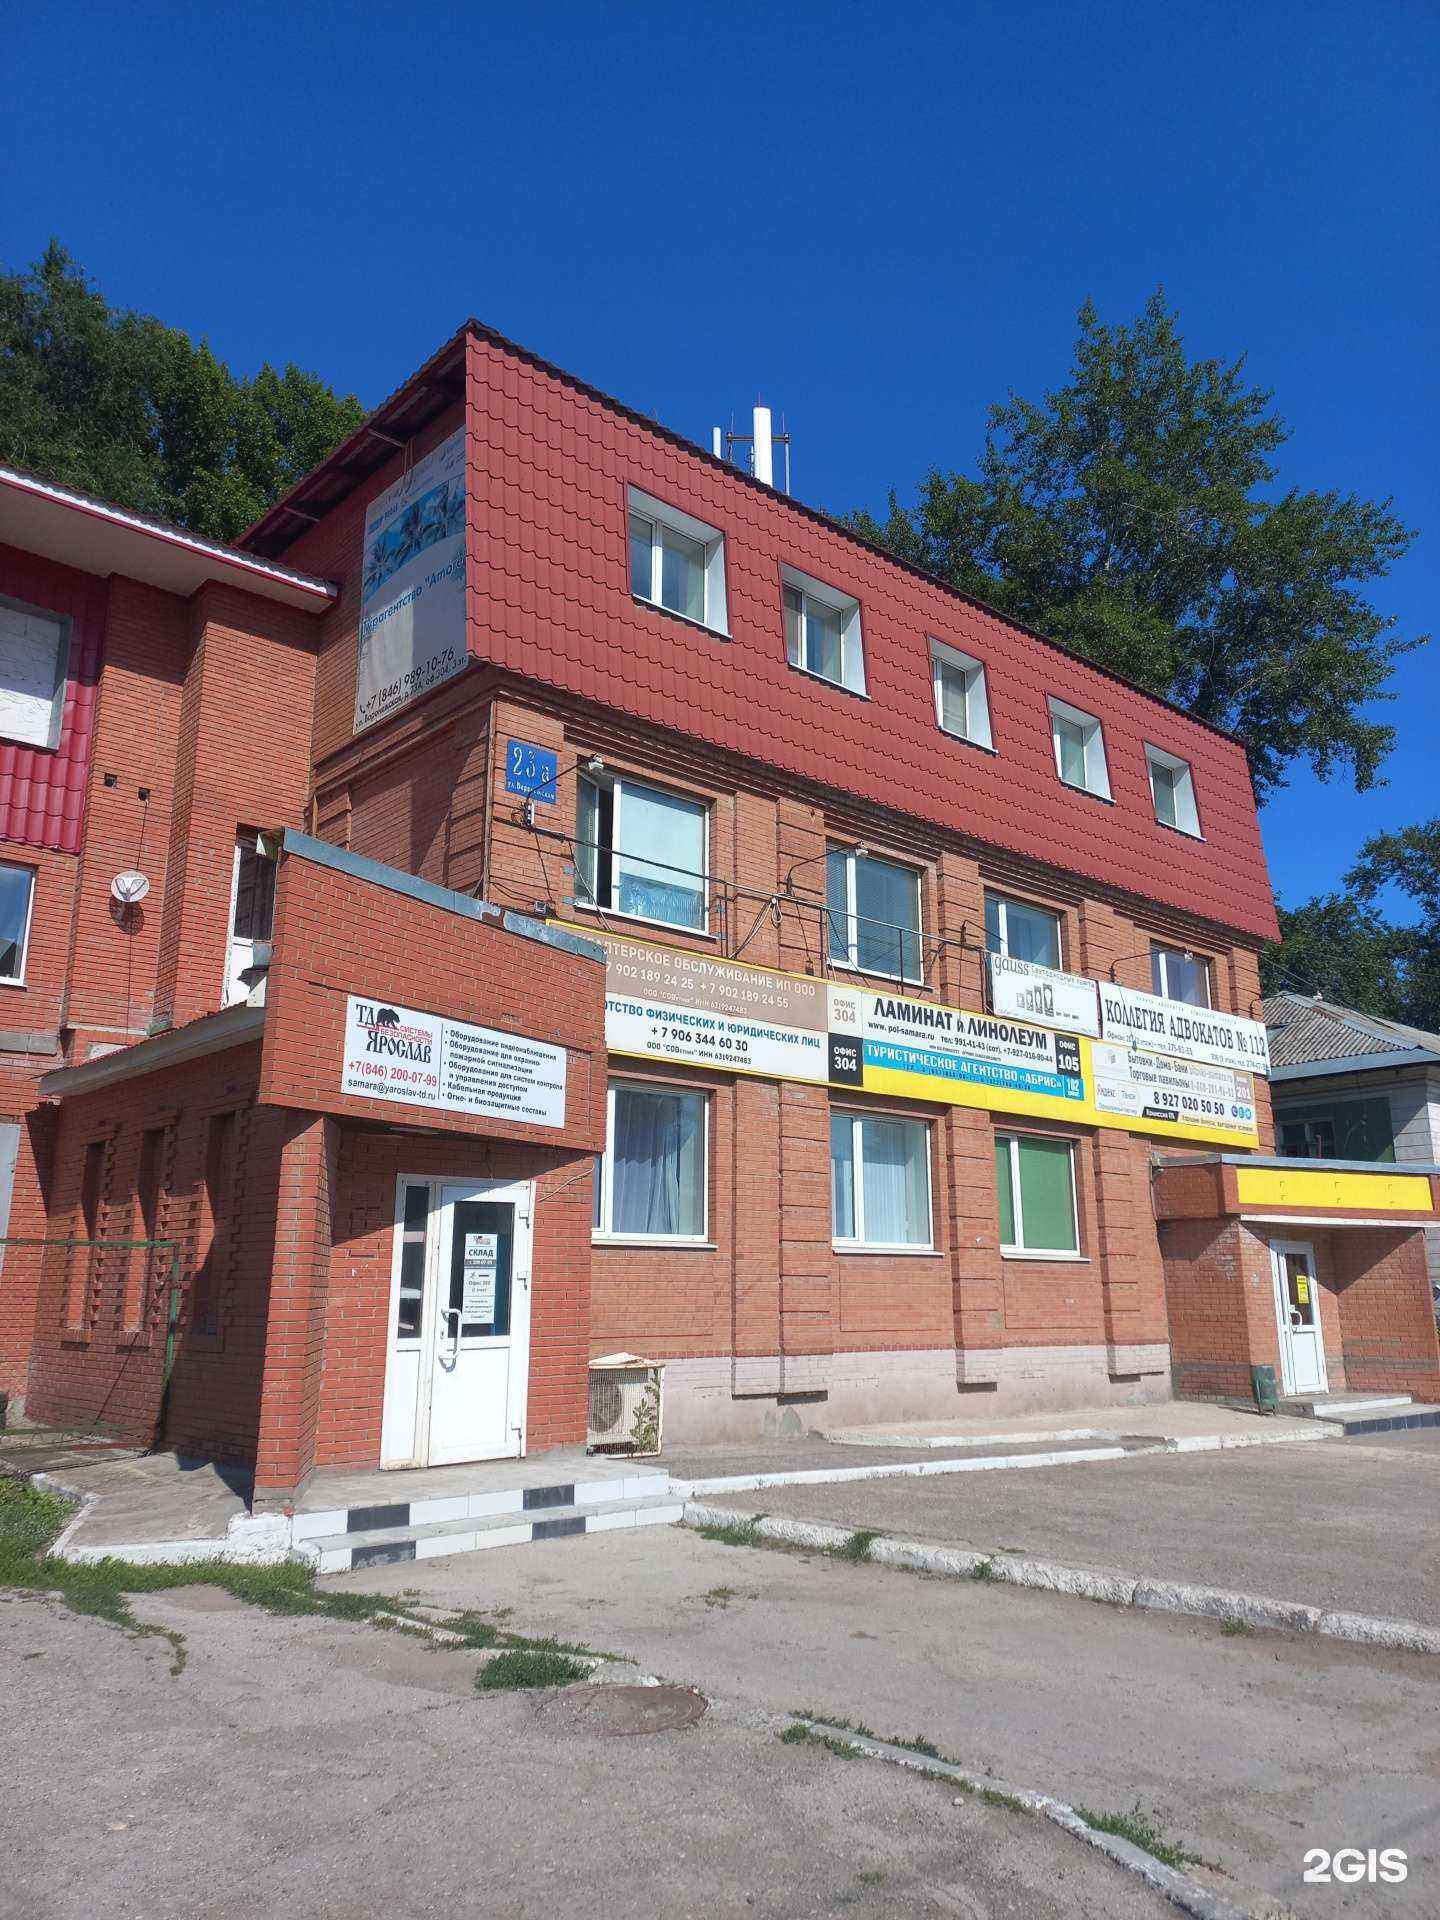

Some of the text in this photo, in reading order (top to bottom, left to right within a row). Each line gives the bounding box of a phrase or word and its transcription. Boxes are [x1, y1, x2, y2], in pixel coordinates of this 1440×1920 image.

[378, 677, 401, 706] (846)
[404, 647, 455, 687] 989-10-76
[674, 956, 773, 989] ОБСЛУЖИВАНИЕ
[776, 980, 791, 991] ИП
[795, 983, 815, 997] ООО
[994, 956, 1029, 976] gauss
[616, 964, 637, 978] 902
[641, 969, 661, 982] 189
[664, 974, 677, 987] 24
[681, 977, 694, 989] 25
[709, 983, 716, 994] 7
[719, 985, 738, 999] 902
[741, 990, 759, 1002] 189
[762, 994, 774, 1006] 24
[777, 997, 789, 1009] 55
[833, 998, 856, 1010] ОФИС
[356, 1004, 375, 1028] ТД
[834, 1008, 856, 1024] 304
[873, 997, 953, 1031] ЛАМИНАТ
[967, 1017, 1047, 1050] ЛИНОЛЕУМ
[1105, 998, 1166, 1035] КОЛЛЕГИЯ
[1170, 1015, 1233, 1049] АДВОКАТОВ
[1236, 1030, 1248, 1053] №
[1249, 1034, 1266, 1057] 112
[380, 1028, 433, 1046] БЕЗОПАСНОСТИ
[400, 1025, 433, 1039] СИСТЕМЫ
[450, 1029, 499, 1046] Оборудование
[645, 1008, 716, 1030] ФИЗИЧЕСКИХ
[718, 1021, 725, 1032] И
[727, 1023, 799, 1044] ЮРИДИЧЕСКИХ
[801, 1036, 821, 1049] ЛИЦ
[661, 1027, 668, 1038] 7
[671, 1028, 692, 1043] 906
[695, 1032, 716, 1047] 344
[719, 1037, 732, 1049] 60
[735, 1039, 748, 1052] 30
[366, 1030, 432, 1064] ЯРОСЛАВ
[449, 1040, 499, 1057] Оборудование
[500, 1053, 512, 1061] для
[646, 1041, 661, 1050] ООО
[698, 1049, 713, 1059] ИНН
[714, 1052, 752, 1065] 6319247483
[833, 1046, 857, 1058] ОФИС
[1059, 1040, 1076, 1051] ОФИС
[349, 1060, 437, 1087] +7(846) 200-07-99
[449, 1052, 533, 1075] пожарной сигнализации
[834, 1056, 857, 1072] 304
[866, 1044, 959, 1072] ТУРИСТИЧЕСКОЕ
[960, 1061, 1018, 1082] АГЕНТСТВО
[1058, 1054, 1079, 1072] 105
[448, 1061, 563, 1091] Оборудование для систем контроля
[455, 1073, 497, 1087] управления
[498, 1083, 528, 1093] доступом
[1129, 1066, 1157, 1082] Торговые
[1158, 1074, 1190, 1089] павильоны
[348, 1079, 436, 1101] samara@yaroslav-td.ru
[447, 1081, 522, 1102] Кабельная продукция
[447, 1092, 467, 1102] Огне-
[474, 1097, 521, 1112] биозащитные
[521, 1106, 547, 1116] составы
[1153, 1091, 1225, 1116] 8 927 020 50 50
[468, 1249, 494, 1257] СКЛАД
